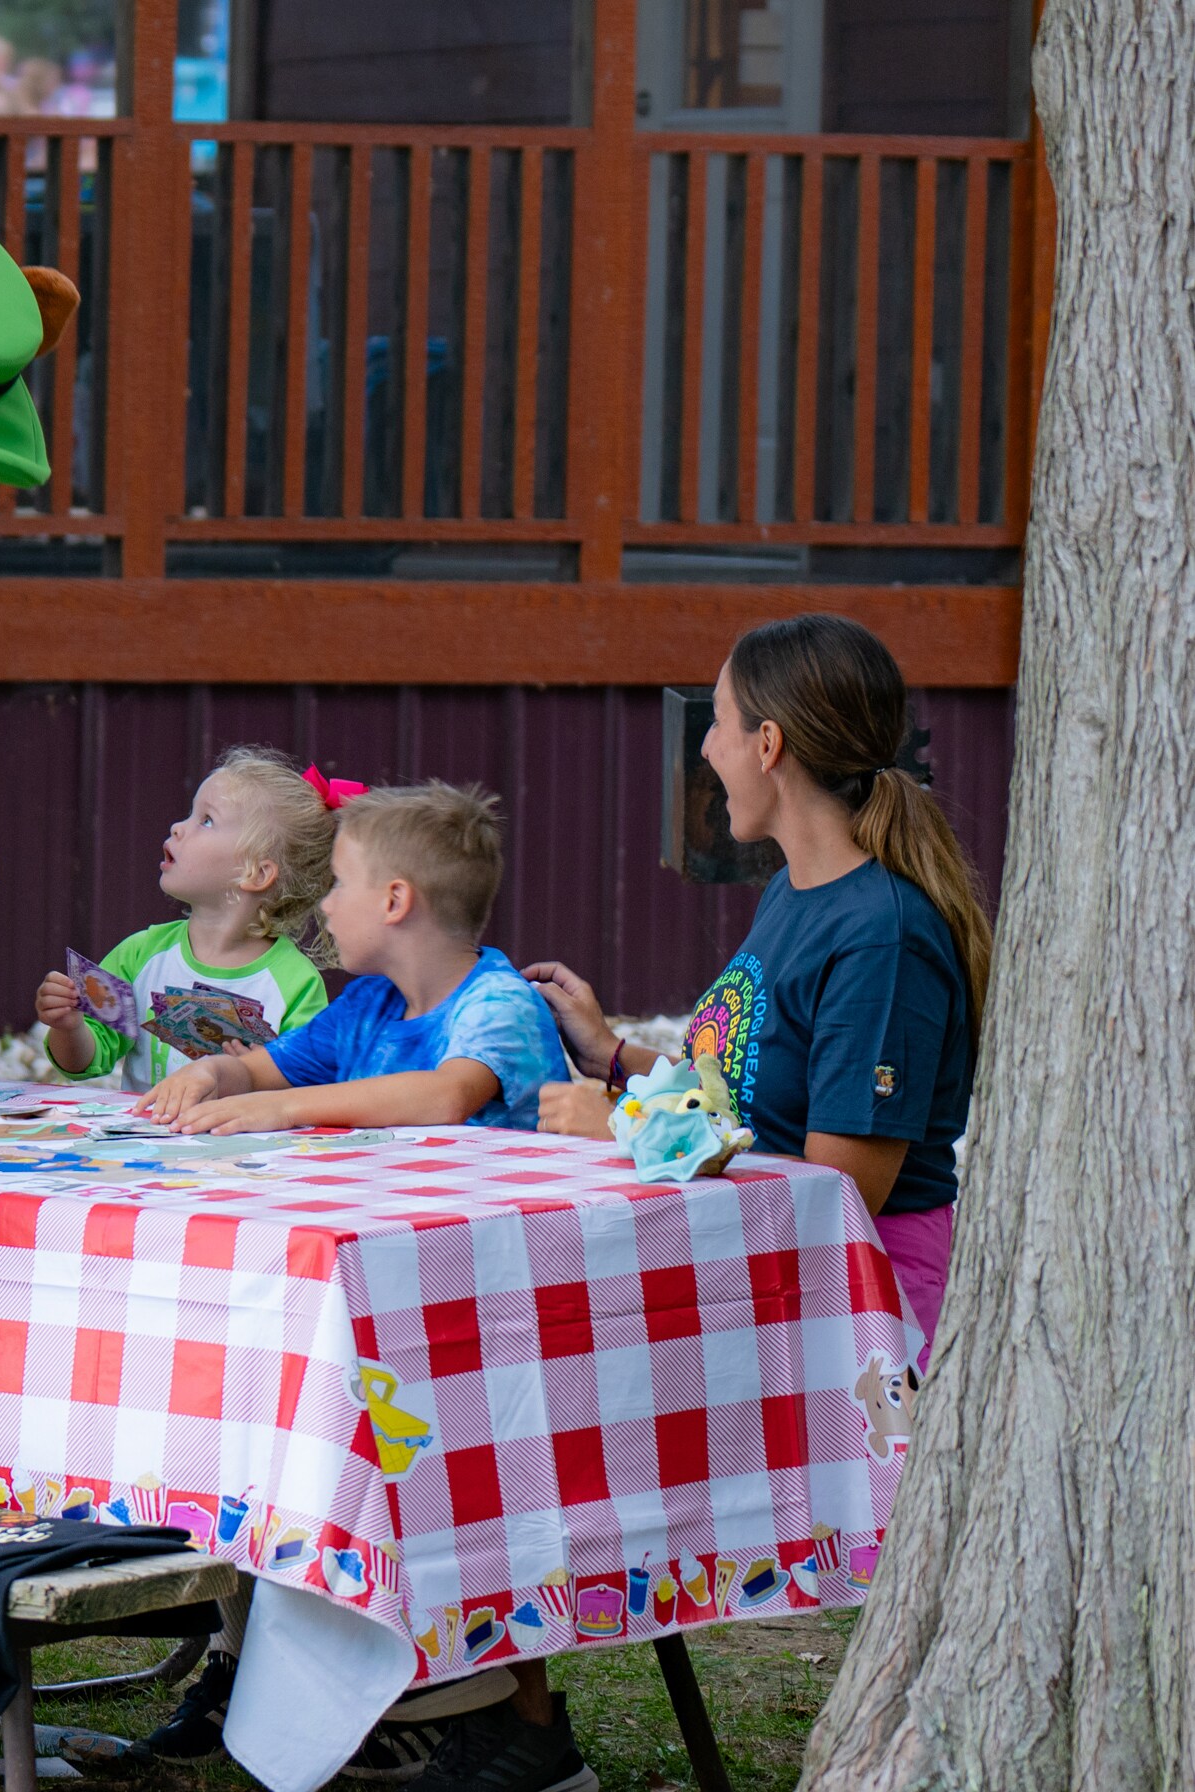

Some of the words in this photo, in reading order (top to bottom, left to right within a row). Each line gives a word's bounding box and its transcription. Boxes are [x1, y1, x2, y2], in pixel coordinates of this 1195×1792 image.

[713, 970, 744, 990] BEAR
[739, 977, 754, 1016] YOGI
[745, 954, 763, 992] BEAR
[721, 988, 742, 1015] YOGI
[749, 988, 767, 1037] YOGI
[715, 1005, 730, 1053] BEAR
[722, 1013, 741, 1073] BEAR
[730, 1017, 751, 1080] BEAR
[740, 1041, 760, 1104] BEAR
